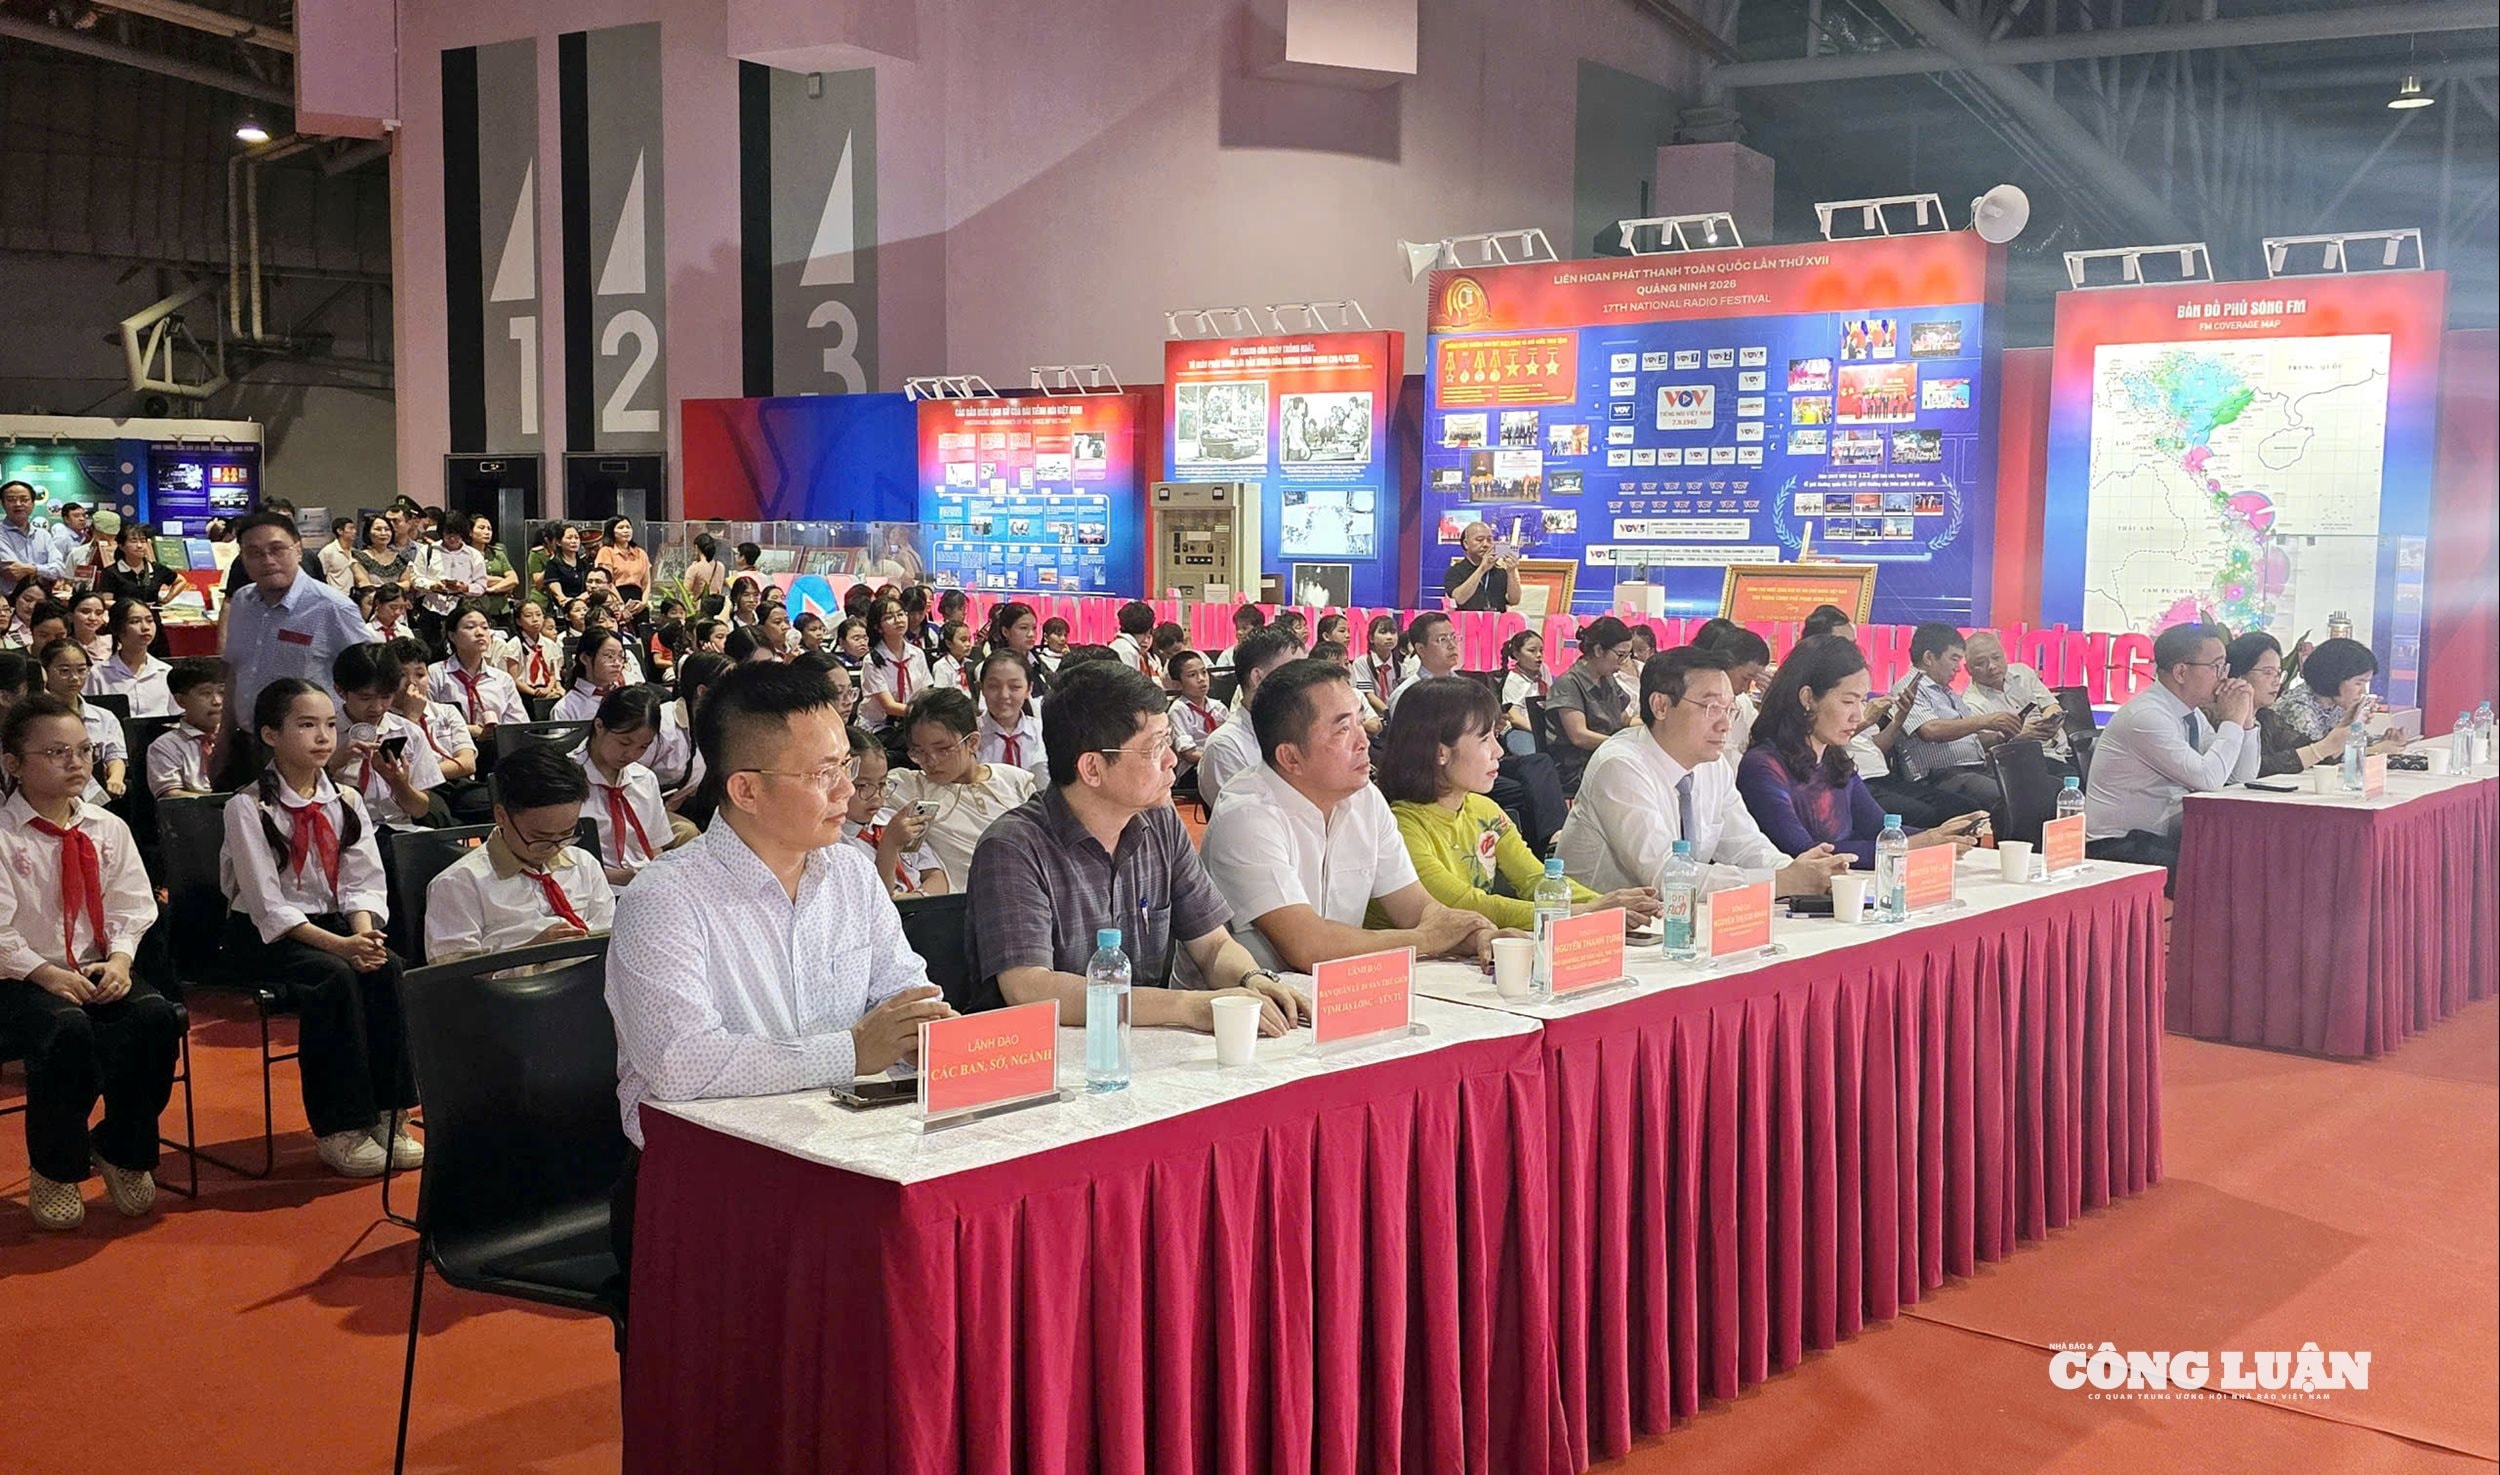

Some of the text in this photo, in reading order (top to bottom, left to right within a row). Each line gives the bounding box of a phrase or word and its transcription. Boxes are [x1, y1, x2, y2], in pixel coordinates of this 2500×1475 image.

[1612, 268, 1641, 280] PHÁT
[1643, 267, 1682, 279] THANH
[1683, 263, 1716, 276] TOÀN
[1717, 259, 1750, 273] QUỐC
[1806, 256, 1829, 267] XVII
[1637, 282, 1677, 296] QUẢNG
[1679, 281, 1707, 293] NINH
[1603, 294, 1771, 313] 17TH NATIONAL RADIO FESTIVAL
[2177, 298, 2307, 319] BẢN ĐỒ PHỦ SÓNG FM
[2199, 319, 2281, 330] FM COVERAGE MAP
[800, 301, 868, 396] 3
[509, 316, 538, 434] 1
[601, 309, 660, 432] 2
[1664, 389, 1708, 408] VOV
[968, 1034, 1020, 1052] LÃNH ĐẠO
[931, 1049, 1052, 1081] CÁC BAN, SỞ, NGÀNH
